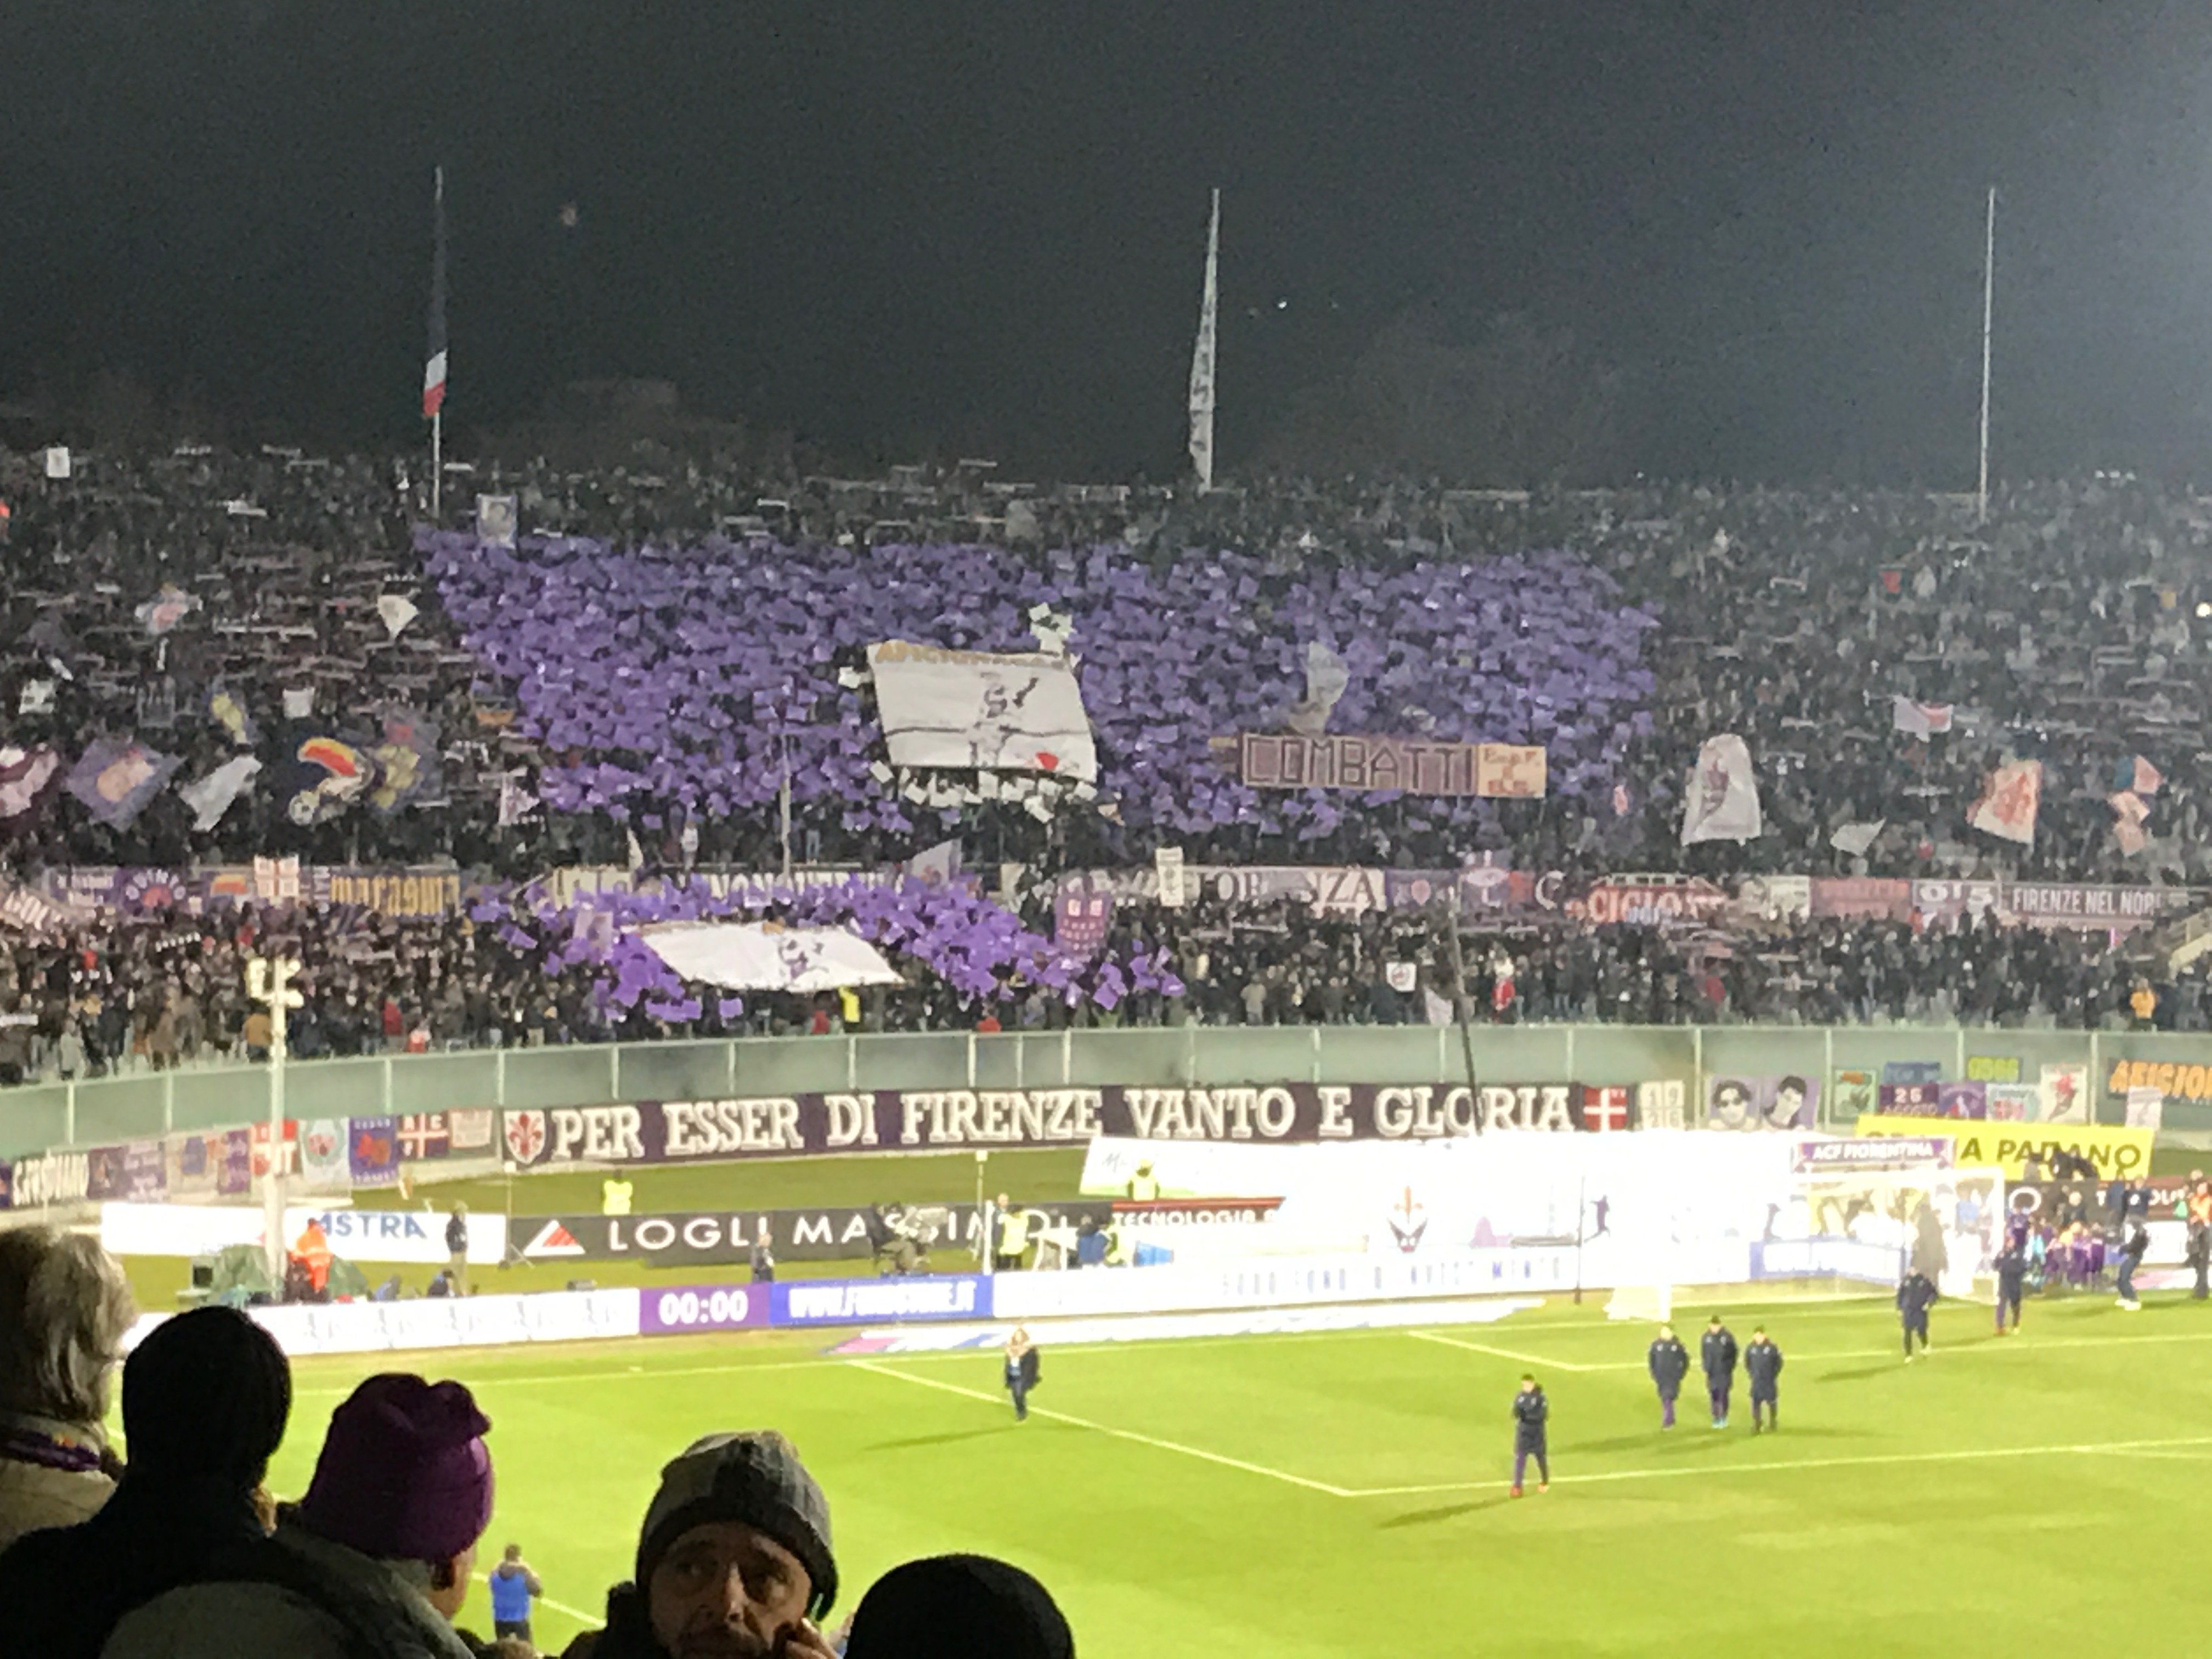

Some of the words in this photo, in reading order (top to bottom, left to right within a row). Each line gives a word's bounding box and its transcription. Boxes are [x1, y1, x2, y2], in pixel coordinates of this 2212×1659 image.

[1248, 737, 1472, 794] COMBATTI
[2013, 887, 2081, 915] FIRENZE
[2085, 889, 2116, 915] NEL
[551, 1105, 645, 1161] PER
[662, 1097, 805, 1155] ESSER
[825, 1093, 879, 1147] DI
[900, 1091, 1103, 1144] FIRENZE
[1123, 1087, 1296, 1138] VANTO
[1319, 1087, 1353, 1137] E
[1374, 1087, 1575, 1137] GLORIA
[609, 1216, 768, 1251] LOGLI
[659, 1290, 748, 1325] 00:00
